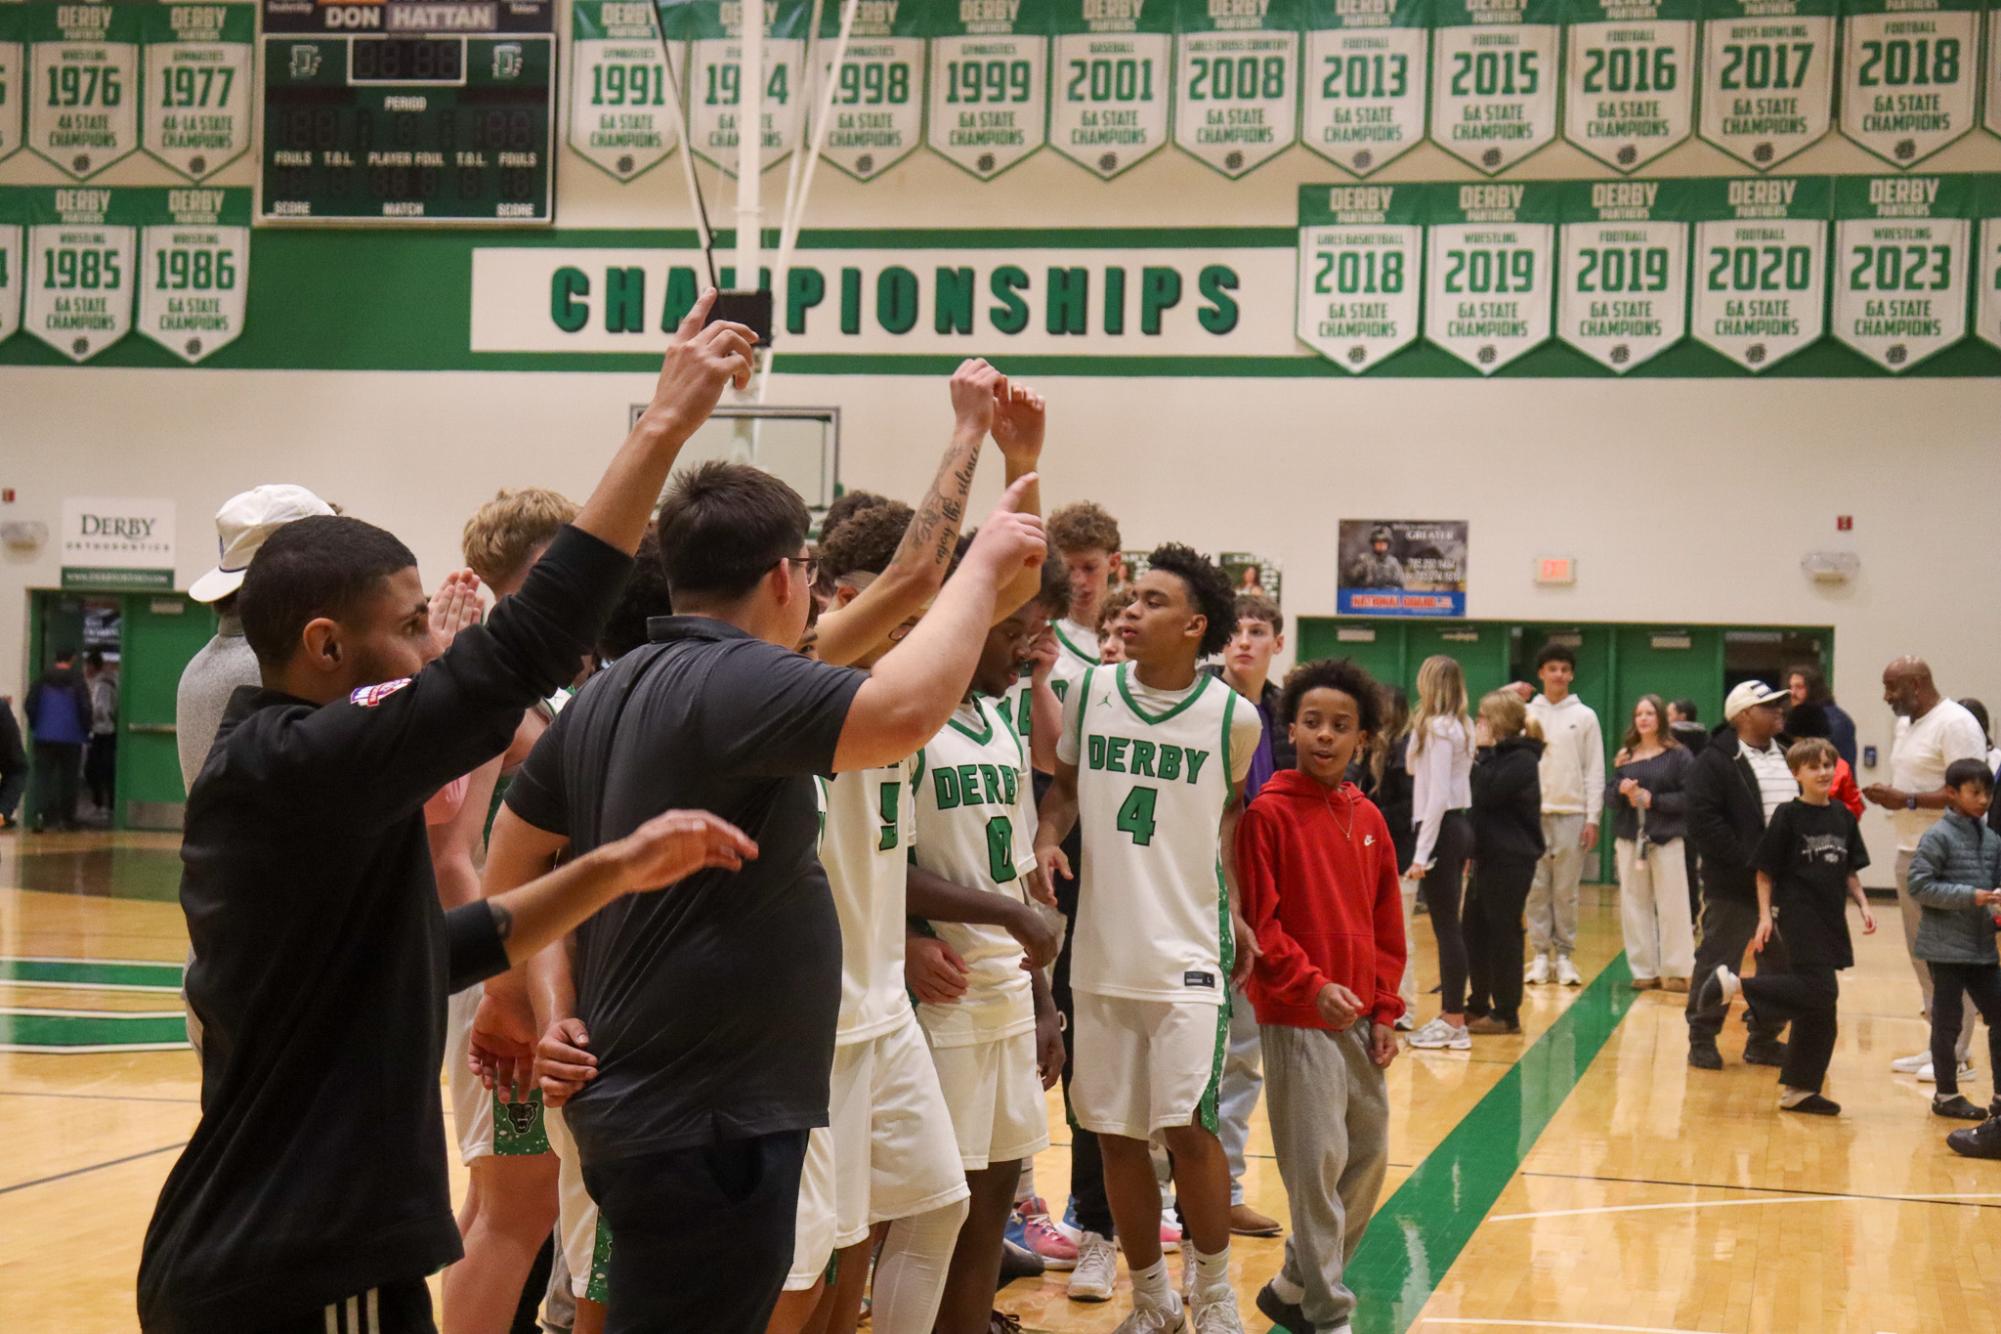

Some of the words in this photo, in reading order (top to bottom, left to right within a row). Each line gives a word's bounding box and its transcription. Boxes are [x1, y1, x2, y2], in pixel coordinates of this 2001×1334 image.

[57, 6, 112, 28] DERBY
[171, 6, 226, 28] DERBY
[325, 6, 381, 28] DON
[391, 6, 494, 28] HATTAN
[960, 0, 1020, 22] DERBY
[1082, 0, 1144, 18] DERBY
[1606, 30, 1654, 41] FOOTBALL
[1885, 21, 1936, 34] FOOTBALL
[1342, 37, 1389, 48] FOOTBALL
[1472, 34, 1519, 45] FOOTBALL
[1584, 47, 1676, 93] 2016
[1721, 43, 1814, 89] 2017
[1859, 38, 1960, 86] 2018
[947, 61, 1030, 103] 1999
[1068, 60, 1153, 101] 2001
[1189, 57, 1285, 100] 2008
[1323, 55, 1408, 98] 2013
[1452, 52, 1538, 96] 2015
[48, 66, 121, 107] 1976
[162, 66, 235, 108] 1977
[592, 64, 665, 105] 1991
[706, 64, 788, 105] 194
[384, 97, 427, 111] PERIOD
[1597, 102, 1616, 118] 6A
[1620, 102, 1660, 118] STATE
[1734, 99, 1752, 115] 6A
[1756, 99, 1797, 115] STATE
[1874, 94, 1893, 111] 6A
[1899, 94, 1940, 111] STATE
[600, 114, 616, 129] 6A
[620, 114, 654, 129] STATE
[838, 112, 854, 128] 6A
[858, 112, 893, 128] STATE
[959, 112, 976, 127] 6A
[979, 112, 1014, 127] STATE
[1082, 111, 1098, 126] 6A
[1102, 111, 1138, 126] STATE
[1207, 109, 1224, 125] 6A
[1228, 109, 1265, 125] STATE
[1334, 107, 1352, 123] 6A
[1355, 107, 1393, 123] STATE
[1463, 105, 1481, 121] 6A
[1484, 105, 1524, 121] STATE
[75, 115, 109, 129] STATE
[199, 115, 232, 130] STATE
[1587, 120, 1669, 137] CHAMPIONS
[1722, 117, 1807, 135] CHAMPIONS
[1863, 113, 1950, 132] CHAMPIONS
[49, 131, 117, 147] CHAMPIONS
[162, 132, 232, 148] CHAMPIONS
[590, 132, 662, 147] CHAMPIONS
[828, 131, 902, 147] CHAMPIONS
[950, 130, 1024, 146] CHAMPIONS
[1071, 128, 1147, 144] CHAMPIONS
[1197, 127, 1274, 143] CHAMPIONS
[1324, 126, 1403, 142] CHAMPIONS
[1453, 123, 1533, 140] CHAMPIONS
[274, 152, 312, 166] FOULS
[368, 152, 412, 166] PLAYER
[415, 152, 445, 166] FOUL
[498, 152, 537, 167] FOULS
[1330, 187, 1393, 211] DERBY
[1459, 185, 1524, 210] DERBY
[1592, 183, 1658, 208] DERBY
[1728, 180, 1797, 205] DERBY
[1870, 178, 1939, 204] DERBY
[56, 190, 111, 212] DERBY
[168, 190, 225, 212] DERBY
[273, 201, 311, 215] SCORE
[383, 202, 424, 216] MATCH
[497, 202, 535, 217] SCORE
[1599, 230, 1648, 242] FOOTBALL
[1735, 228, 1785, 241] FOOTBALL
[1874, 228, 1932, 240] WRESTLING
[44, 250, 121, 289] 1985
[156, 250, 235, 289] 1986
[1315, 251, 1404, 293] 2018
[1445, 250, 1534, 293] 2019
[1577, 247, 1668, 292] 2019
[1708, 246, 1811, 291] 2020
[1850, 245, 1951, 290] 2023
[74, 298, 106, 312] STATE
[187, 298, 220, 312] STATE
[550, 265, 1240, 336] CHAPIONSHIPS
[1726, 300, 1745, 316] 6A
[1750, 300, 1790, 316] STATE
[1866, 300, 1885, 317] 6A
[1890, 300, 1931, 317] STATE
[1329, 303, 1346, 319] 6A
[1350, 303, 1387, 319] STATE
[1458, 303, 1477, 318] 6A
[1479, 303, 1519, 318] STATE
[1590, 302, 1609, 317] 6A
[1613, 302, 1652, 317] STATE
[46, 315, 115, 330] CHAMPIONS
[159, 315, 229, 331] CHAMPIONS
[1319, 321, 1397, 338] CHAMPIONS
[1448, 321, 1528, 337] CHAMPIONS
[1580, 320, 1662, 336] CHAMPIONS
[1715, 319, 1799, 336] CHAMPIONS
[1855, 319, 1941, 336] CHAMPIONS
[1088, 735, 1209, 784] DERBY
[932, 764, 1019, 810] DERB
[1117, 786, 1157, 846] 4
[986, 816, 1017, 883] 0
